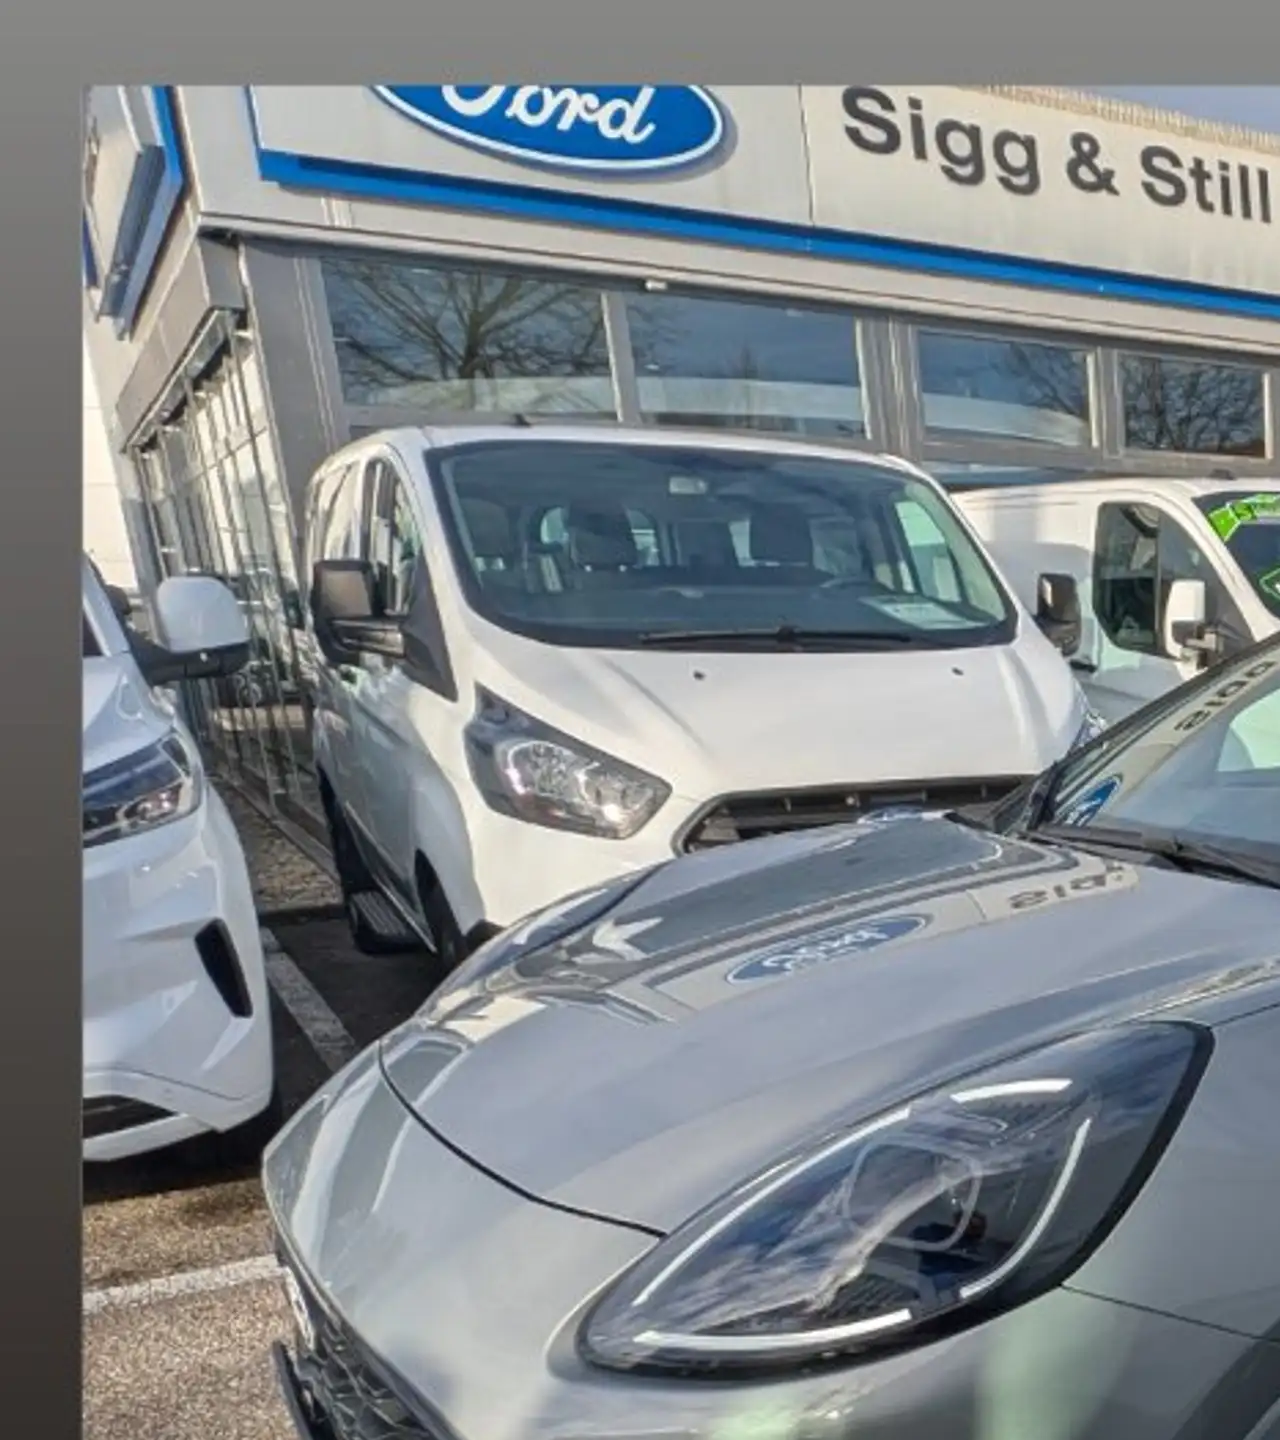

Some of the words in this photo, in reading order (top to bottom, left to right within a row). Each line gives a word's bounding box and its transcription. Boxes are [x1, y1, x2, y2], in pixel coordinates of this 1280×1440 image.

[842, 86, 1040, 195] Sigg
[1067, 133, 1119, 195] &
[1141, 146, 1271, 223] Still
